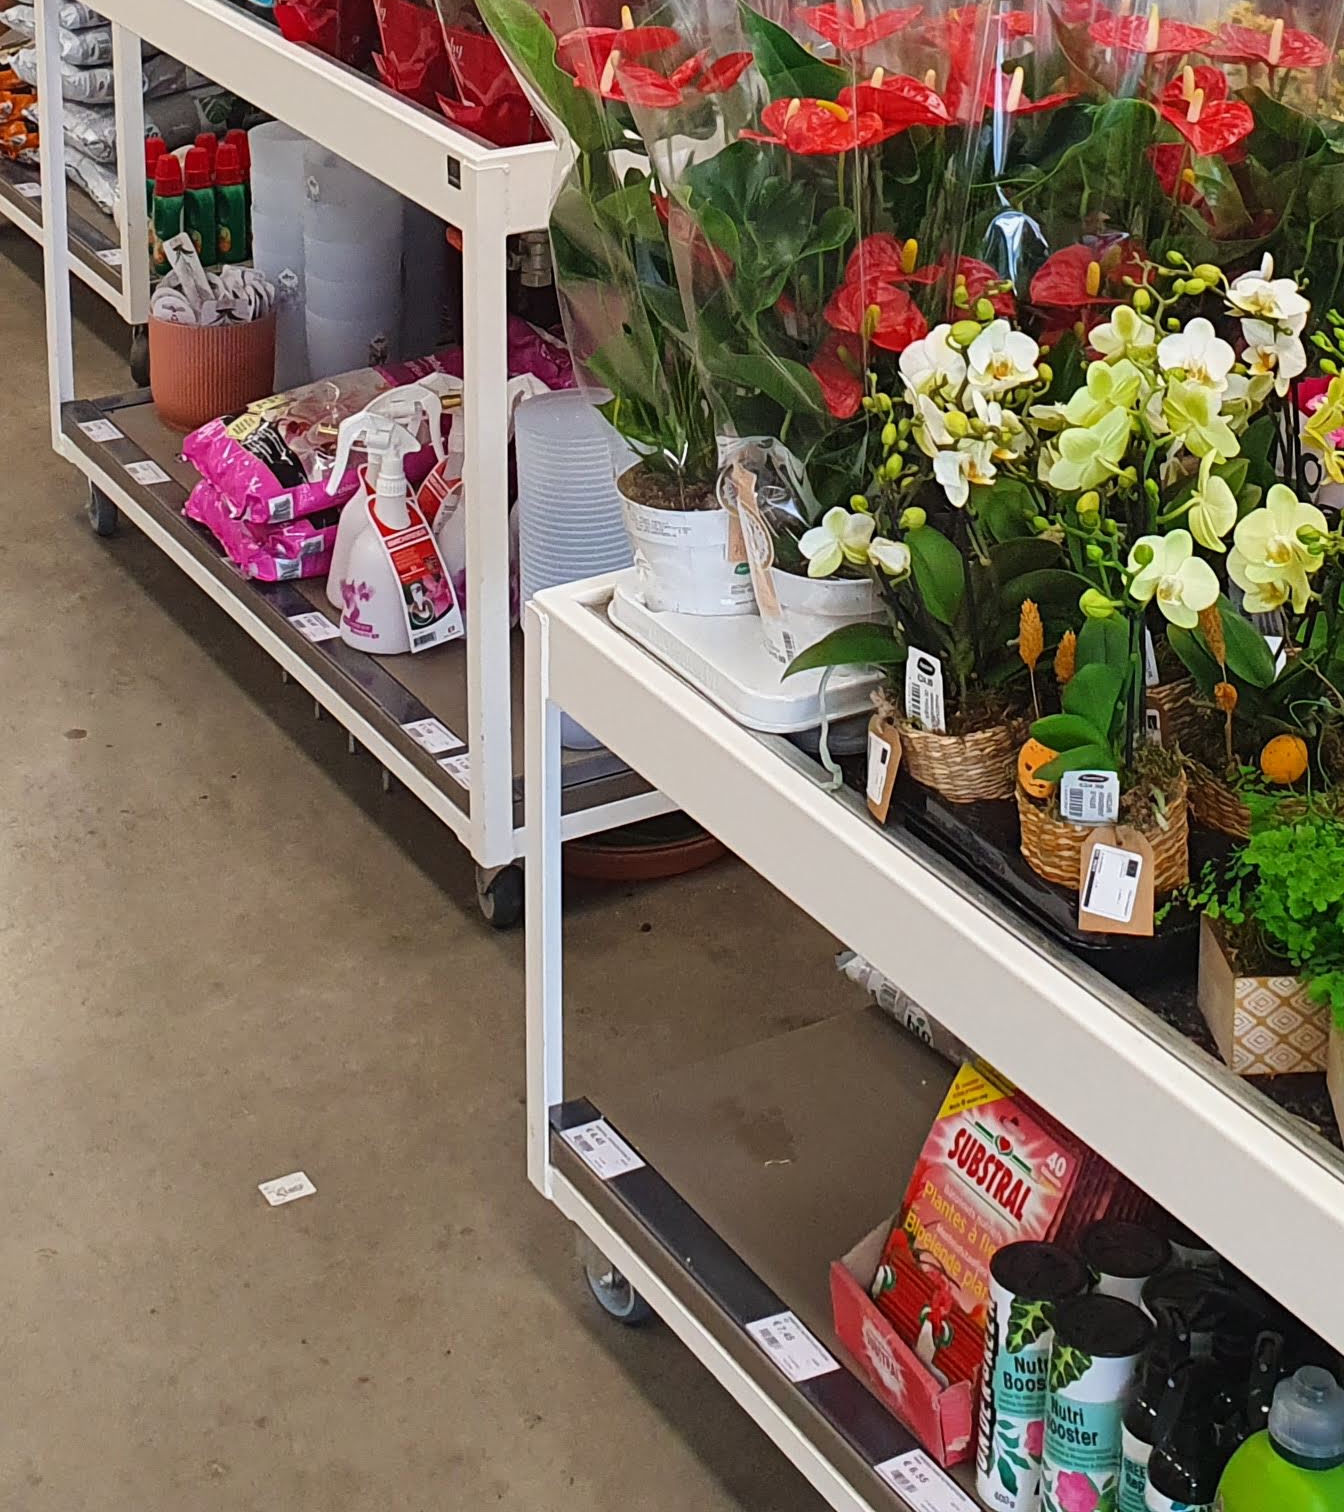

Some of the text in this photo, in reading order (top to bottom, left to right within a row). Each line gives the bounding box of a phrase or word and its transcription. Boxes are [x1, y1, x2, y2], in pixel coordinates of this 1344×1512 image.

[947, 1127, 1032, 1221] SUBSTRAL
[1046, 1152, 1067, 1177] 40
[923, 1180, 966, 1234] Plantes
[968, 1223, 978, 1243] à
[904, 1212, 962, 1278] Bloeiende
[1003, 1370, 1048, 1392] Boos
[1051, 1395, 1084, 1426] Nutri
